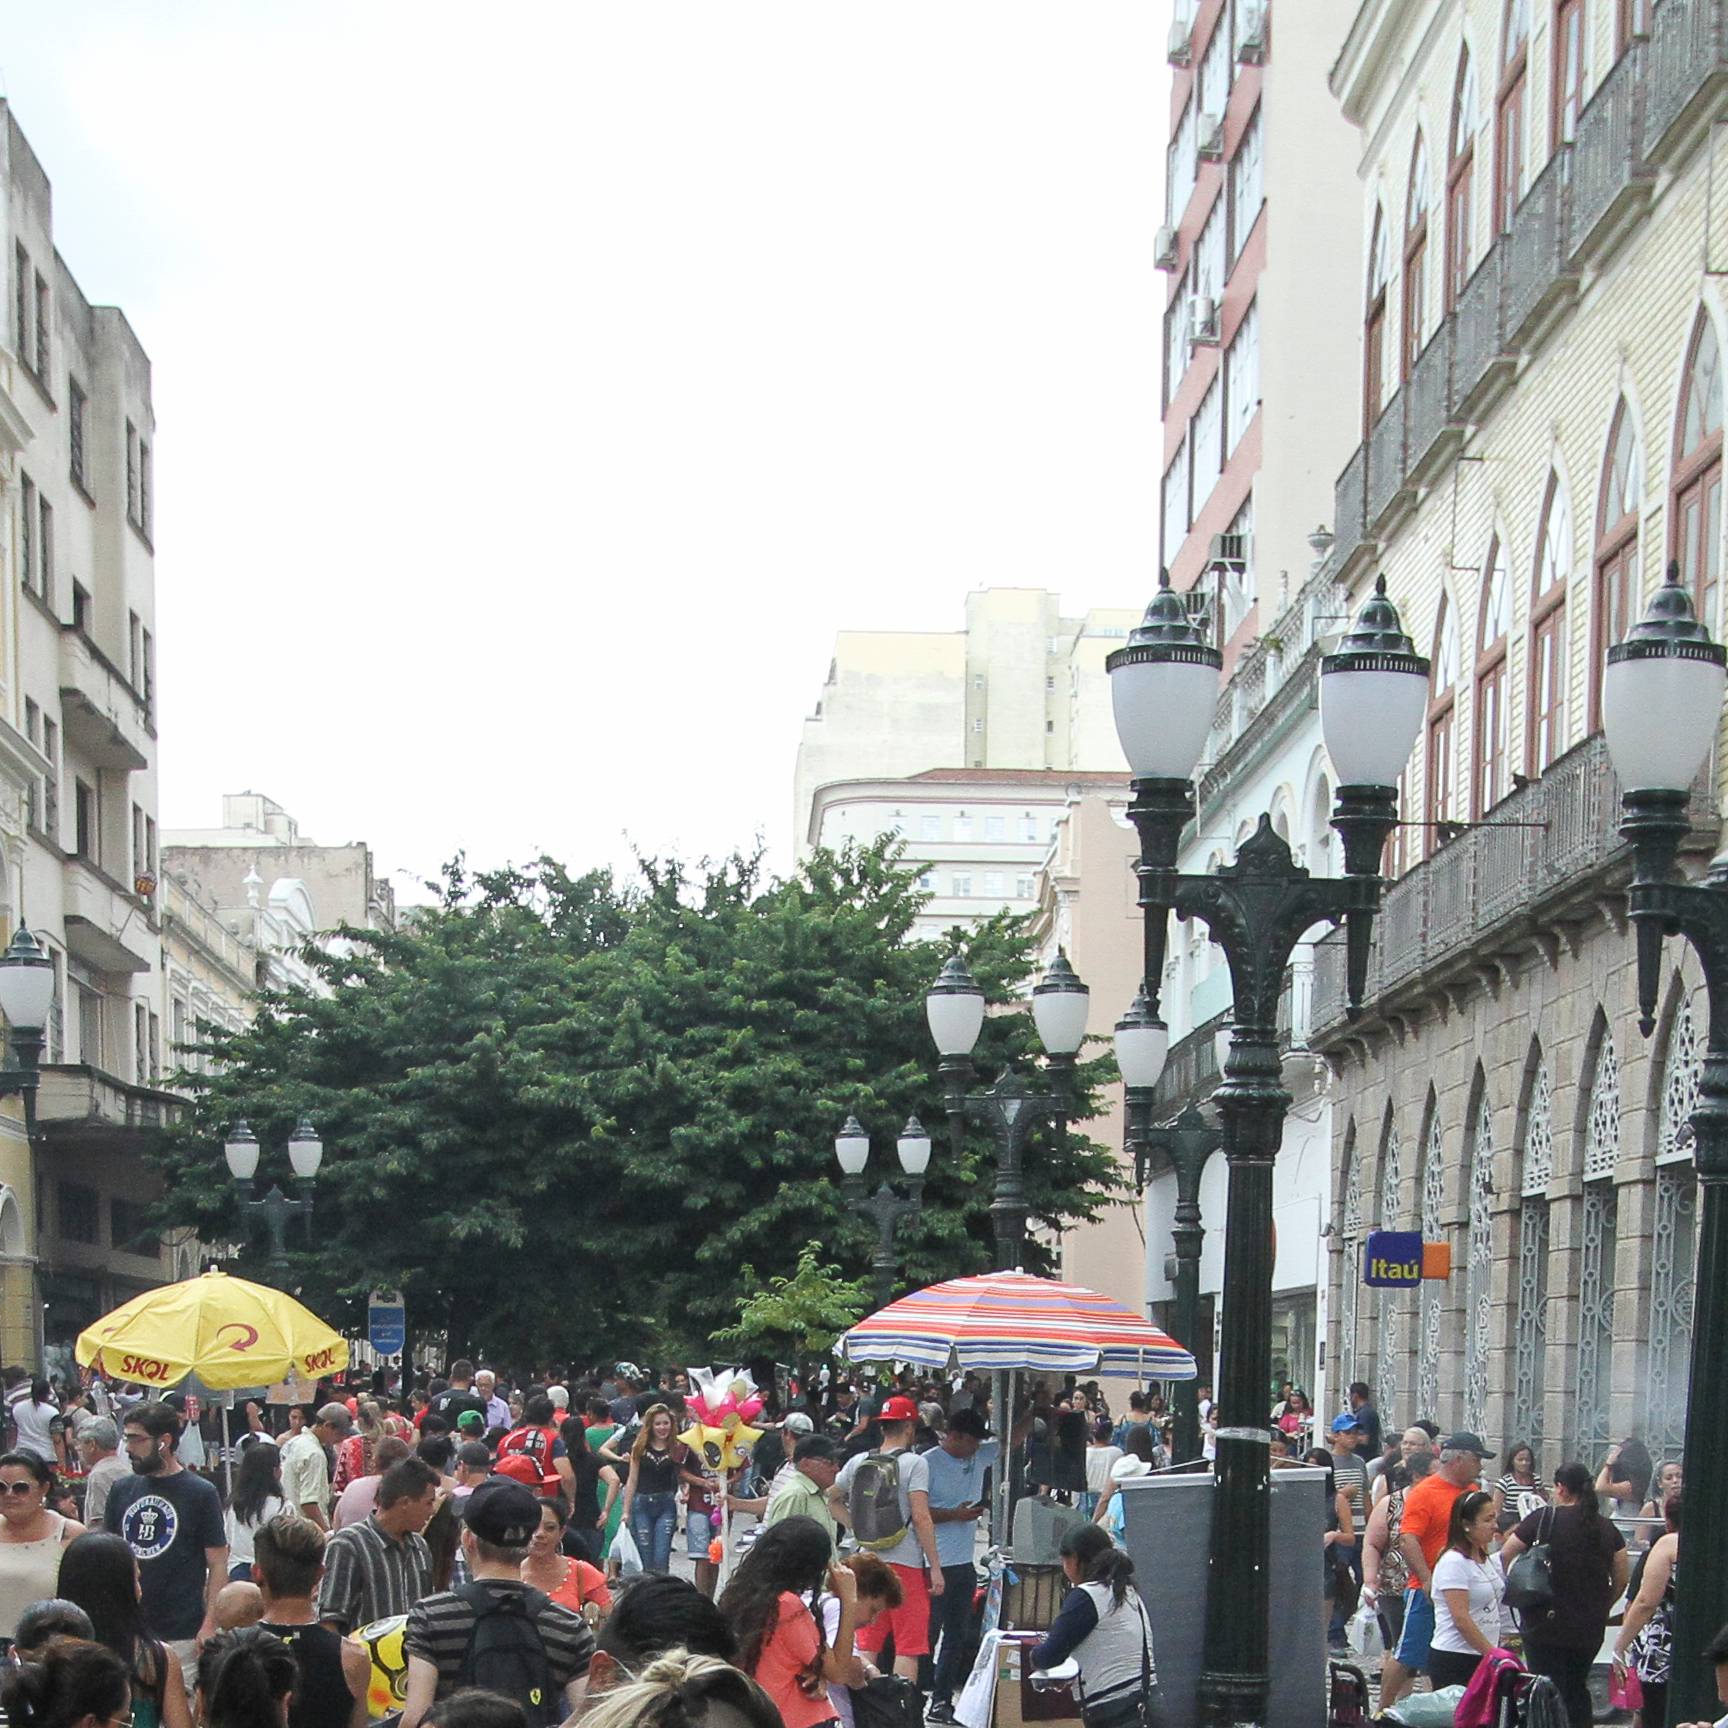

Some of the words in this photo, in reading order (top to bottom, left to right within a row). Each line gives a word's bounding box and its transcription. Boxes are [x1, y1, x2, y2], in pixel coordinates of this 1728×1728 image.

[1371, 1258, 1419, 1279] Itaú
[121, 1354, 171, 1381] SKOL
[304, 1348, 336, 1373] SKOL
